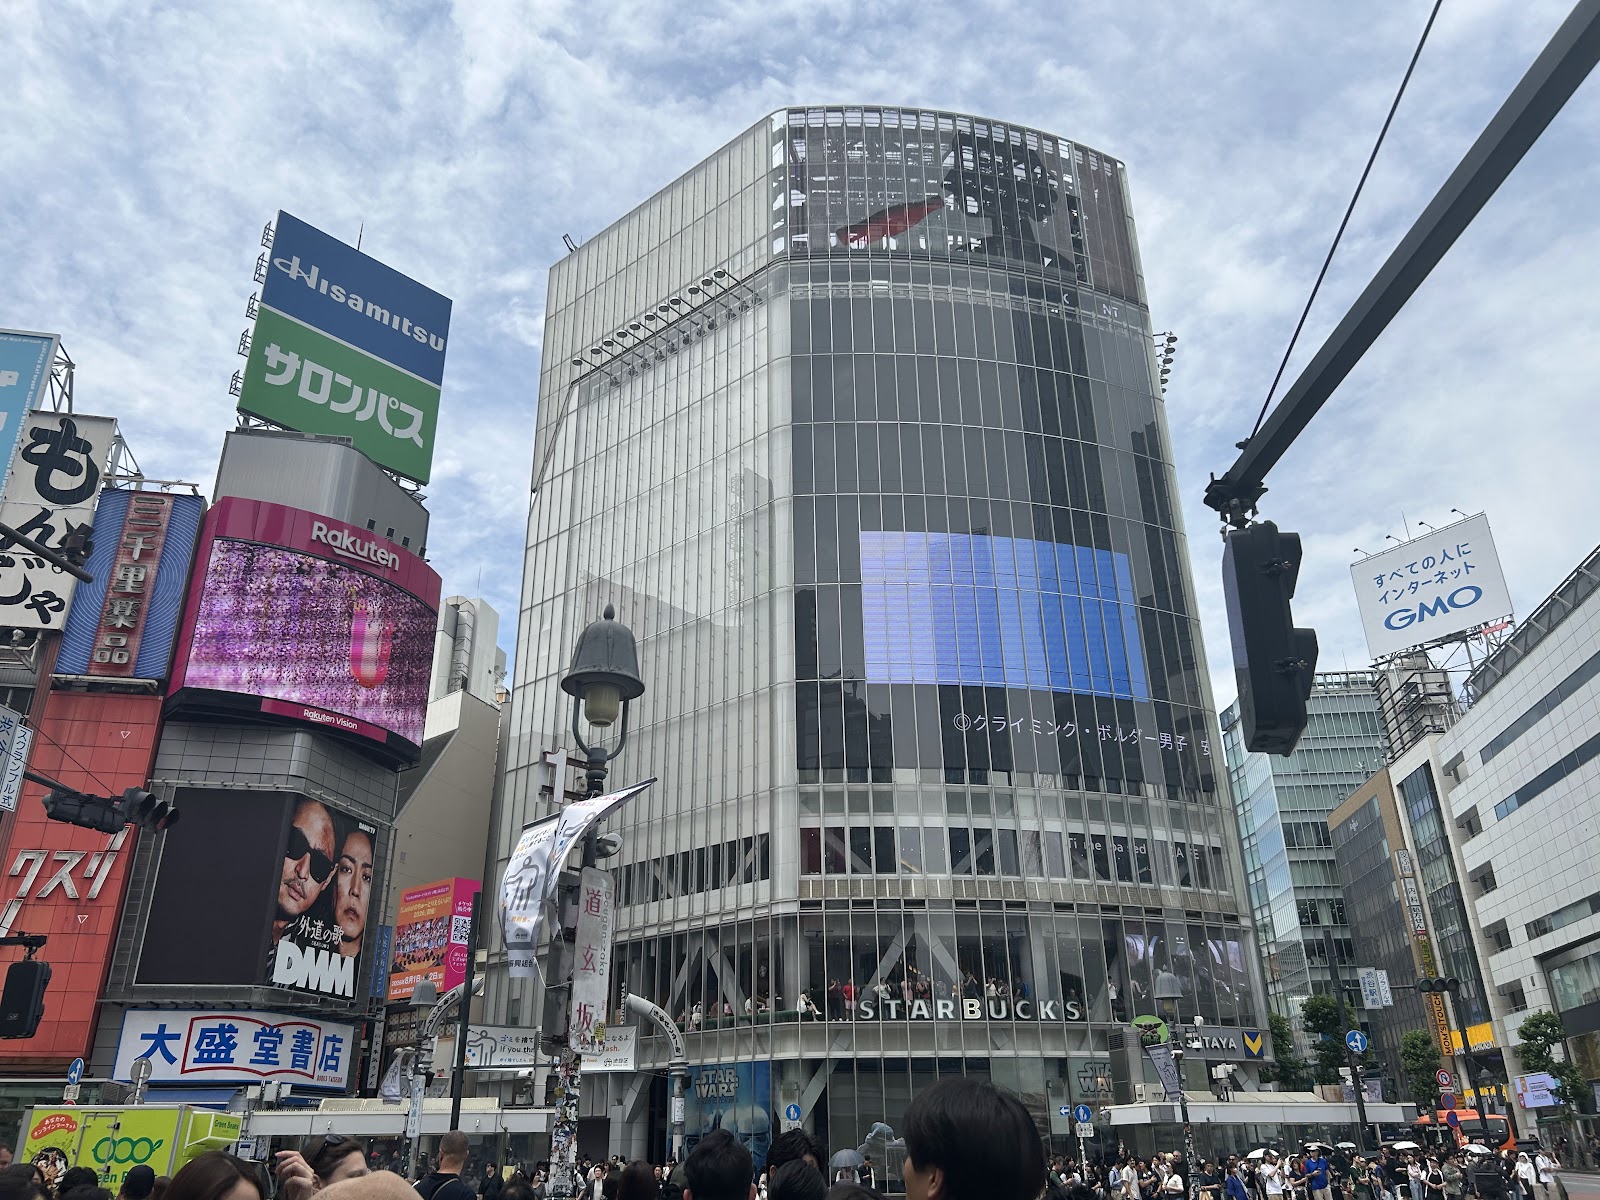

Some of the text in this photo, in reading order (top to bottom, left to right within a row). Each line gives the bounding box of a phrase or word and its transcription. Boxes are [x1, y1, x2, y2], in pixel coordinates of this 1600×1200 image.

[273, 255, 445, 352] Hisamitsu
[264, 343, 424, 449] サロンパス
[311, 521, 400, 571] Rakuten
[1373, 542, 1472, 588] すべての人に
[93, 496, 165, 665] 三千里薬品
[1378, 561, 1476, 605] インターネット
[1384, 585, 1483, 631] GMO
[303, 709, 358, 730] Rakuten Vision
[9, 850, 117, 899] クスリ
[300, 914, 344, 946] 外道の歌
[273, 940, 354, 998] DMM
[574, 886, 602, 1035] 道玄坂
[859, 998, 1081, 1021] STARBUCKS
[1433, 994, 1444, 1023] TOUCH
[134, 1023, 343, 1072] 大盛堂書店
[1440, 1026, 1452, 1054] MOM'S
[695, 1069, 739, 1084] STAR
[695, 1083, 739, 1099] WARS
[1077, 1062, 1112, 1078] STA
[97, 1173, 117, 1183] een
